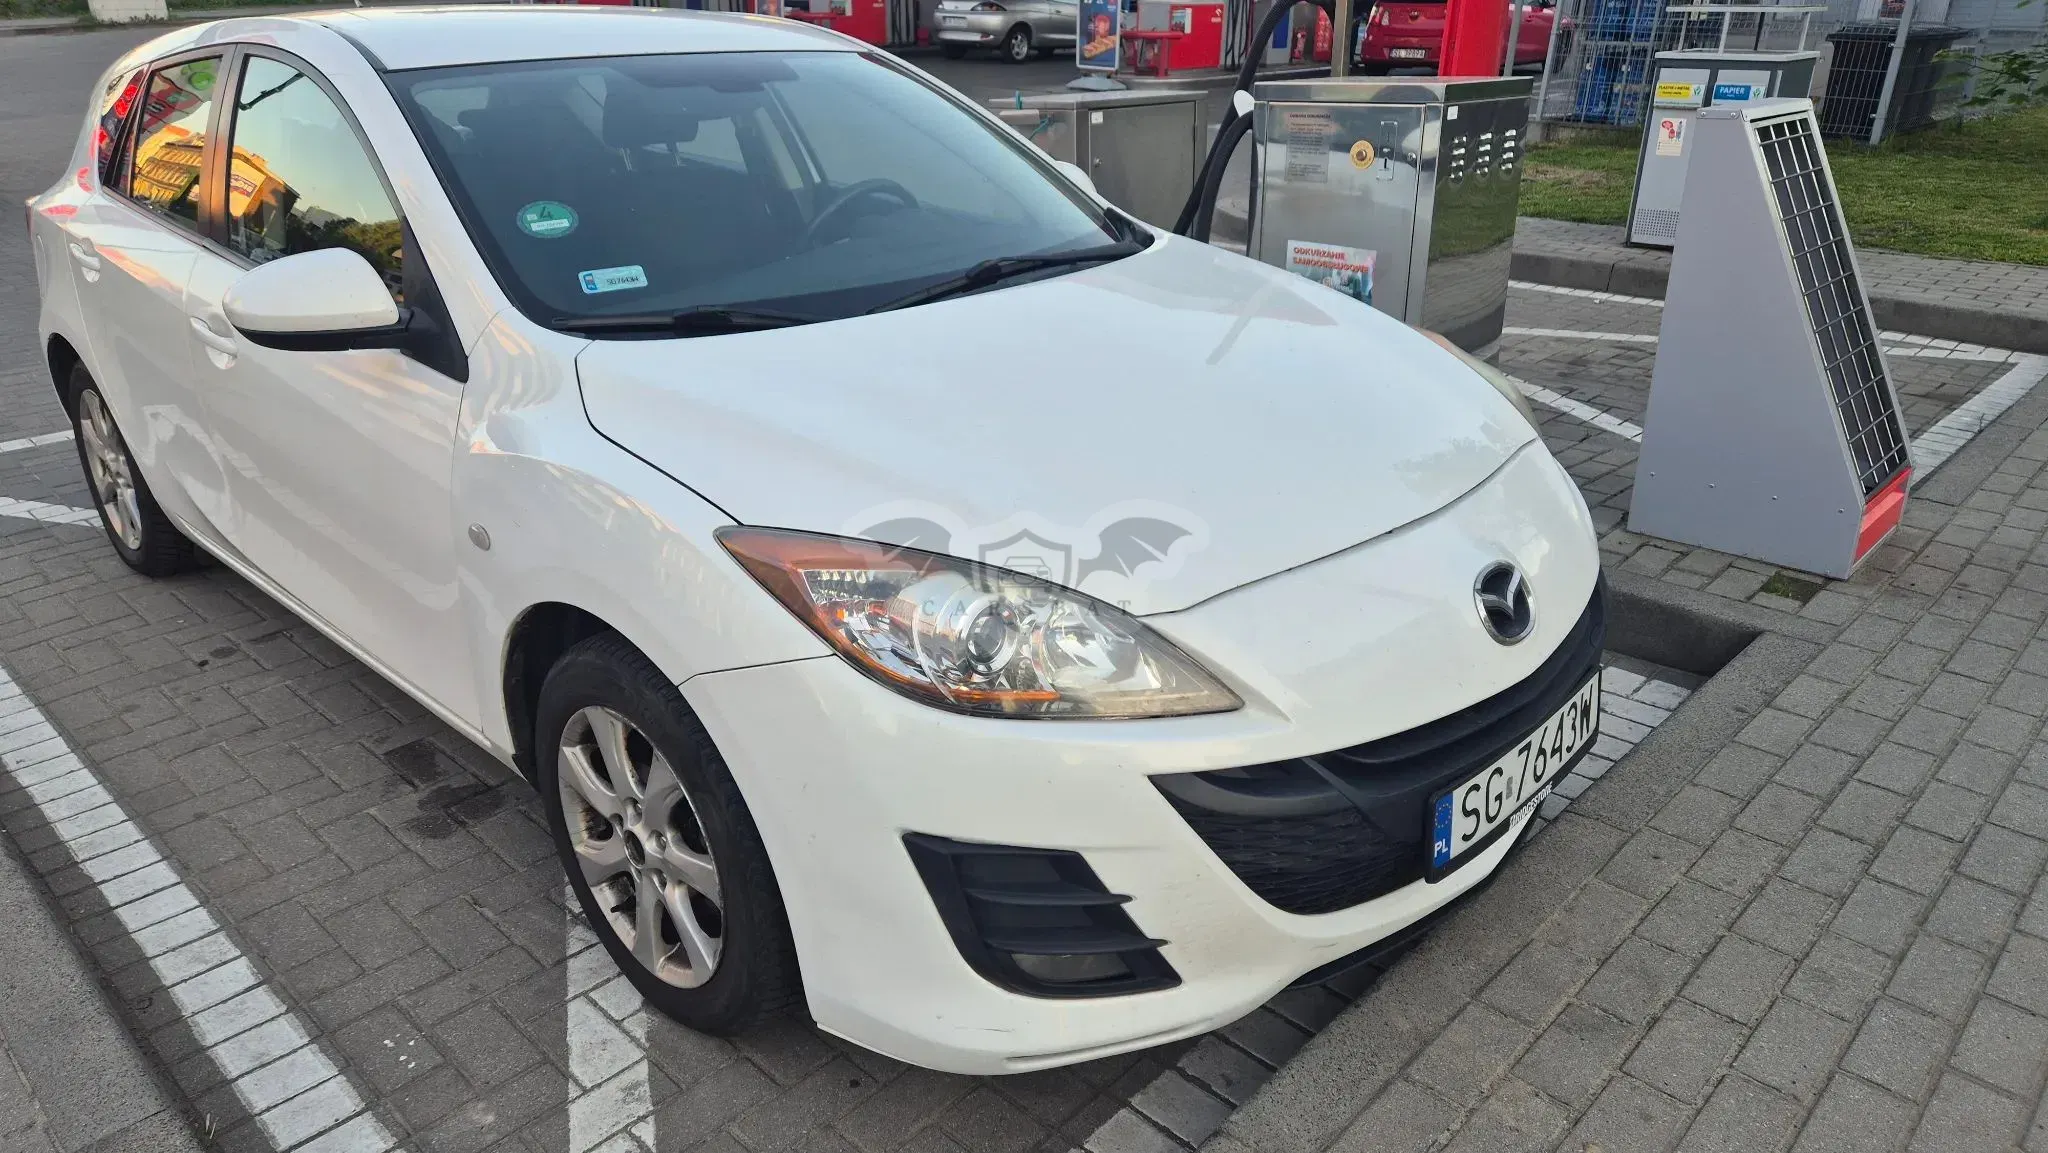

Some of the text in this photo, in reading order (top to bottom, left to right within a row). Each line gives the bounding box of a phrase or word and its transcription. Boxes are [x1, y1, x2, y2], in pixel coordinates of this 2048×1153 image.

[1720, 86, 1745, 95] PAPIER
[1293, 246, 1346, 260] ODKURZANIE
[1461, 684, 1594, 843] SG 7643W
[1433, 839, 1448, 859] PL
